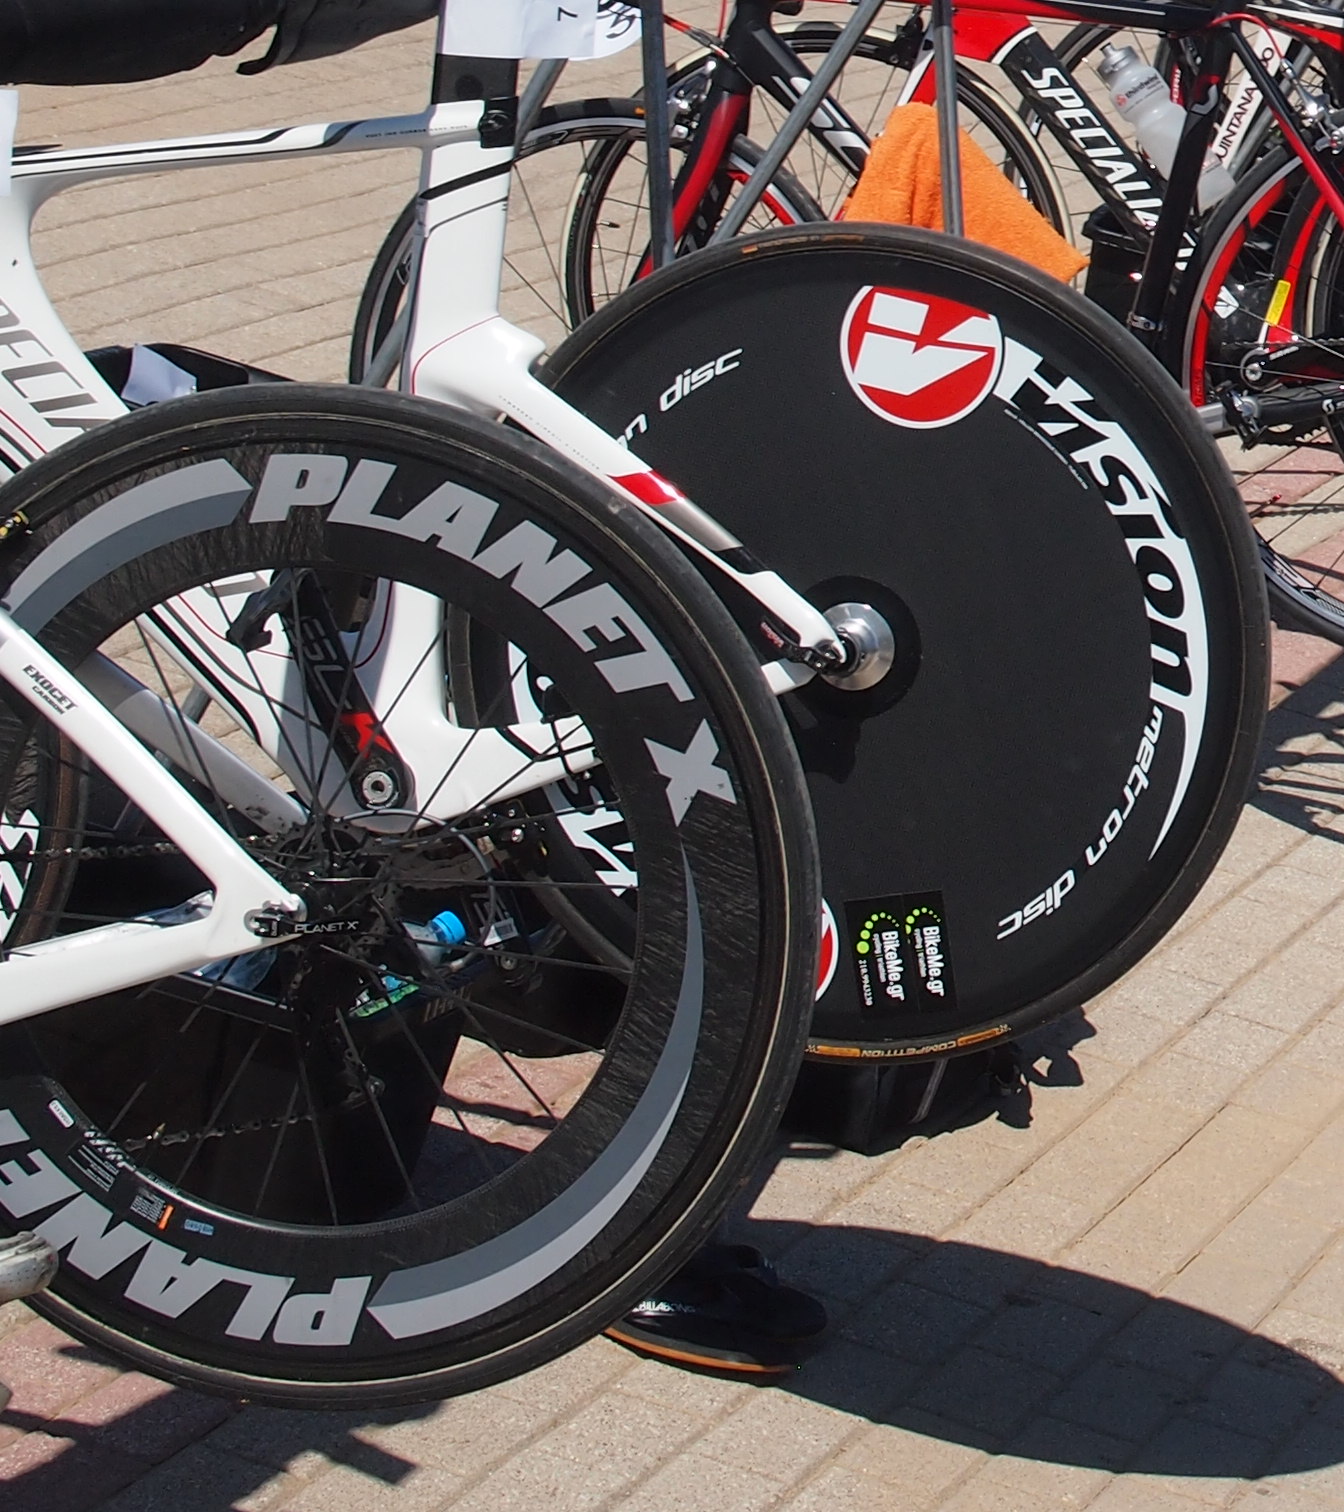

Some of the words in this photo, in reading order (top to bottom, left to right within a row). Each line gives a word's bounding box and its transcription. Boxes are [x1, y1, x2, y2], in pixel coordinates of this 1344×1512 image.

[659, 346, 745, 411] disc
[249, 453, 696, 703] PLANET
[643, 717, 738, 828] X
[22, 663, 79, 712] EXOCET
[1084, 709, 1165, 867] metron
[294, 921, 344, 934] PLANET
[997, 867, 1076, 940] disc
[882, 931, 905, 1002] BikeMe.gr
[922, 926, 945, 997] BikeMe.gr
[860, 1040, 957, 1058] COMPETITION
